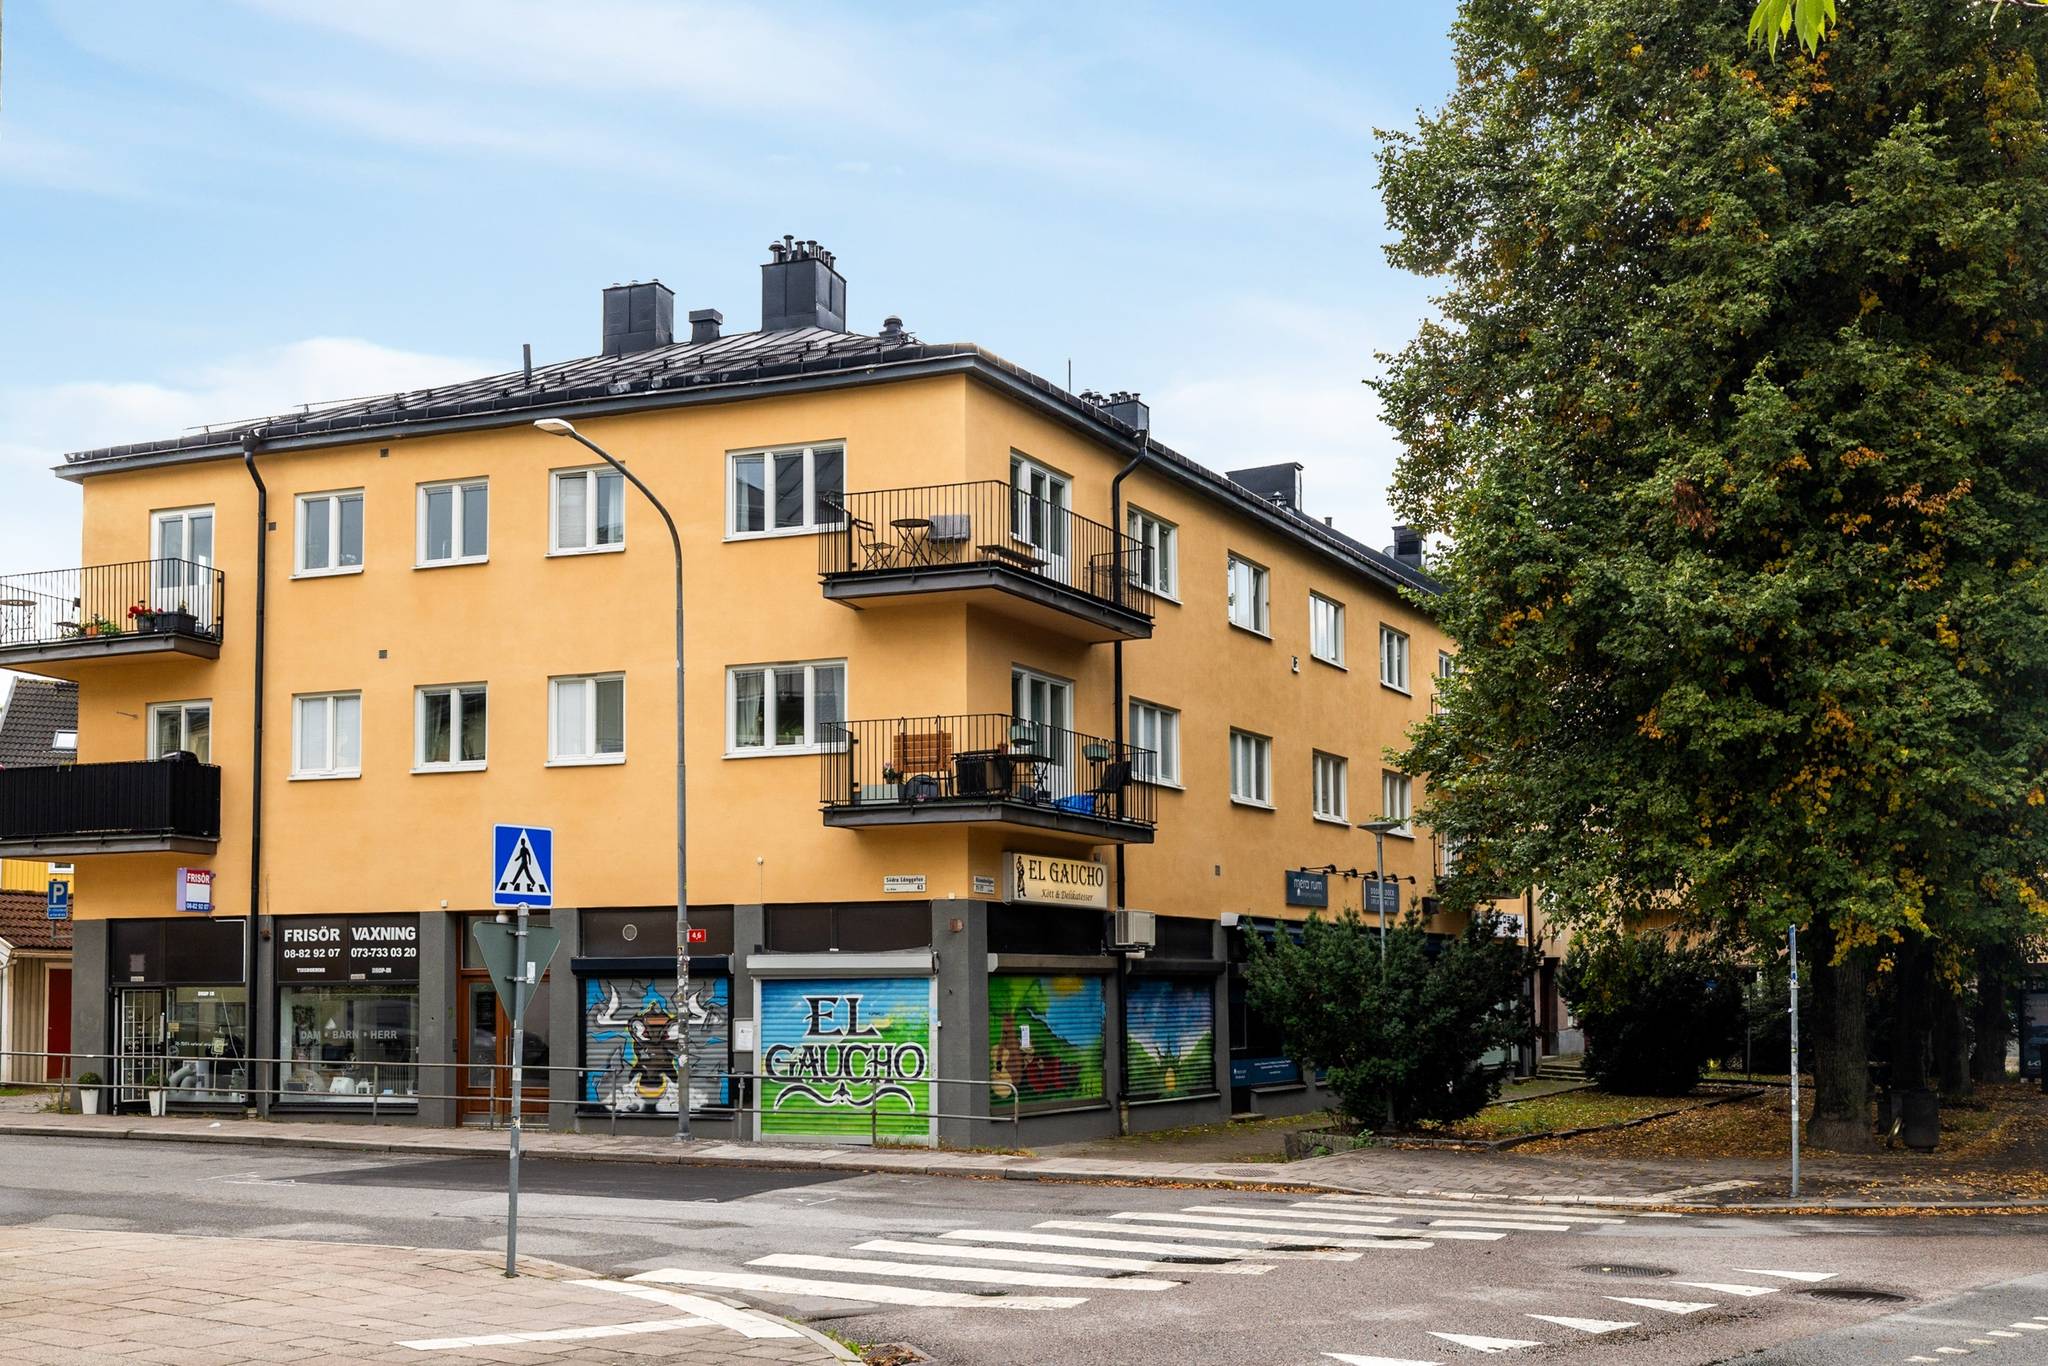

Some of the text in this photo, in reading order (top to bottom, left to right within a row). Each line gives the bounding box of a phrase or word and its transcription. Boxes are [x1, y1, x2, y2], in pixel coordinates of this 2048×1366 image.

[187, 872, 210, 884] FRISÖR
[1029, 860, 1104, 887] EL GAUCHO
[53, 884, 65, 904] P
[284, 926, 340, 942] FRISÖR
[351, 926, 416, 941] VAXNING
[284, 948, 340, 958] 08-82 92 07
[351, 947, 417, 958] 073-733 03 20
[802, 994, 883, 1039] EL
[301, 1030, 397, 1040] DAM BARN HERR
[764, 1041, 928, 1084] GAUCHO
